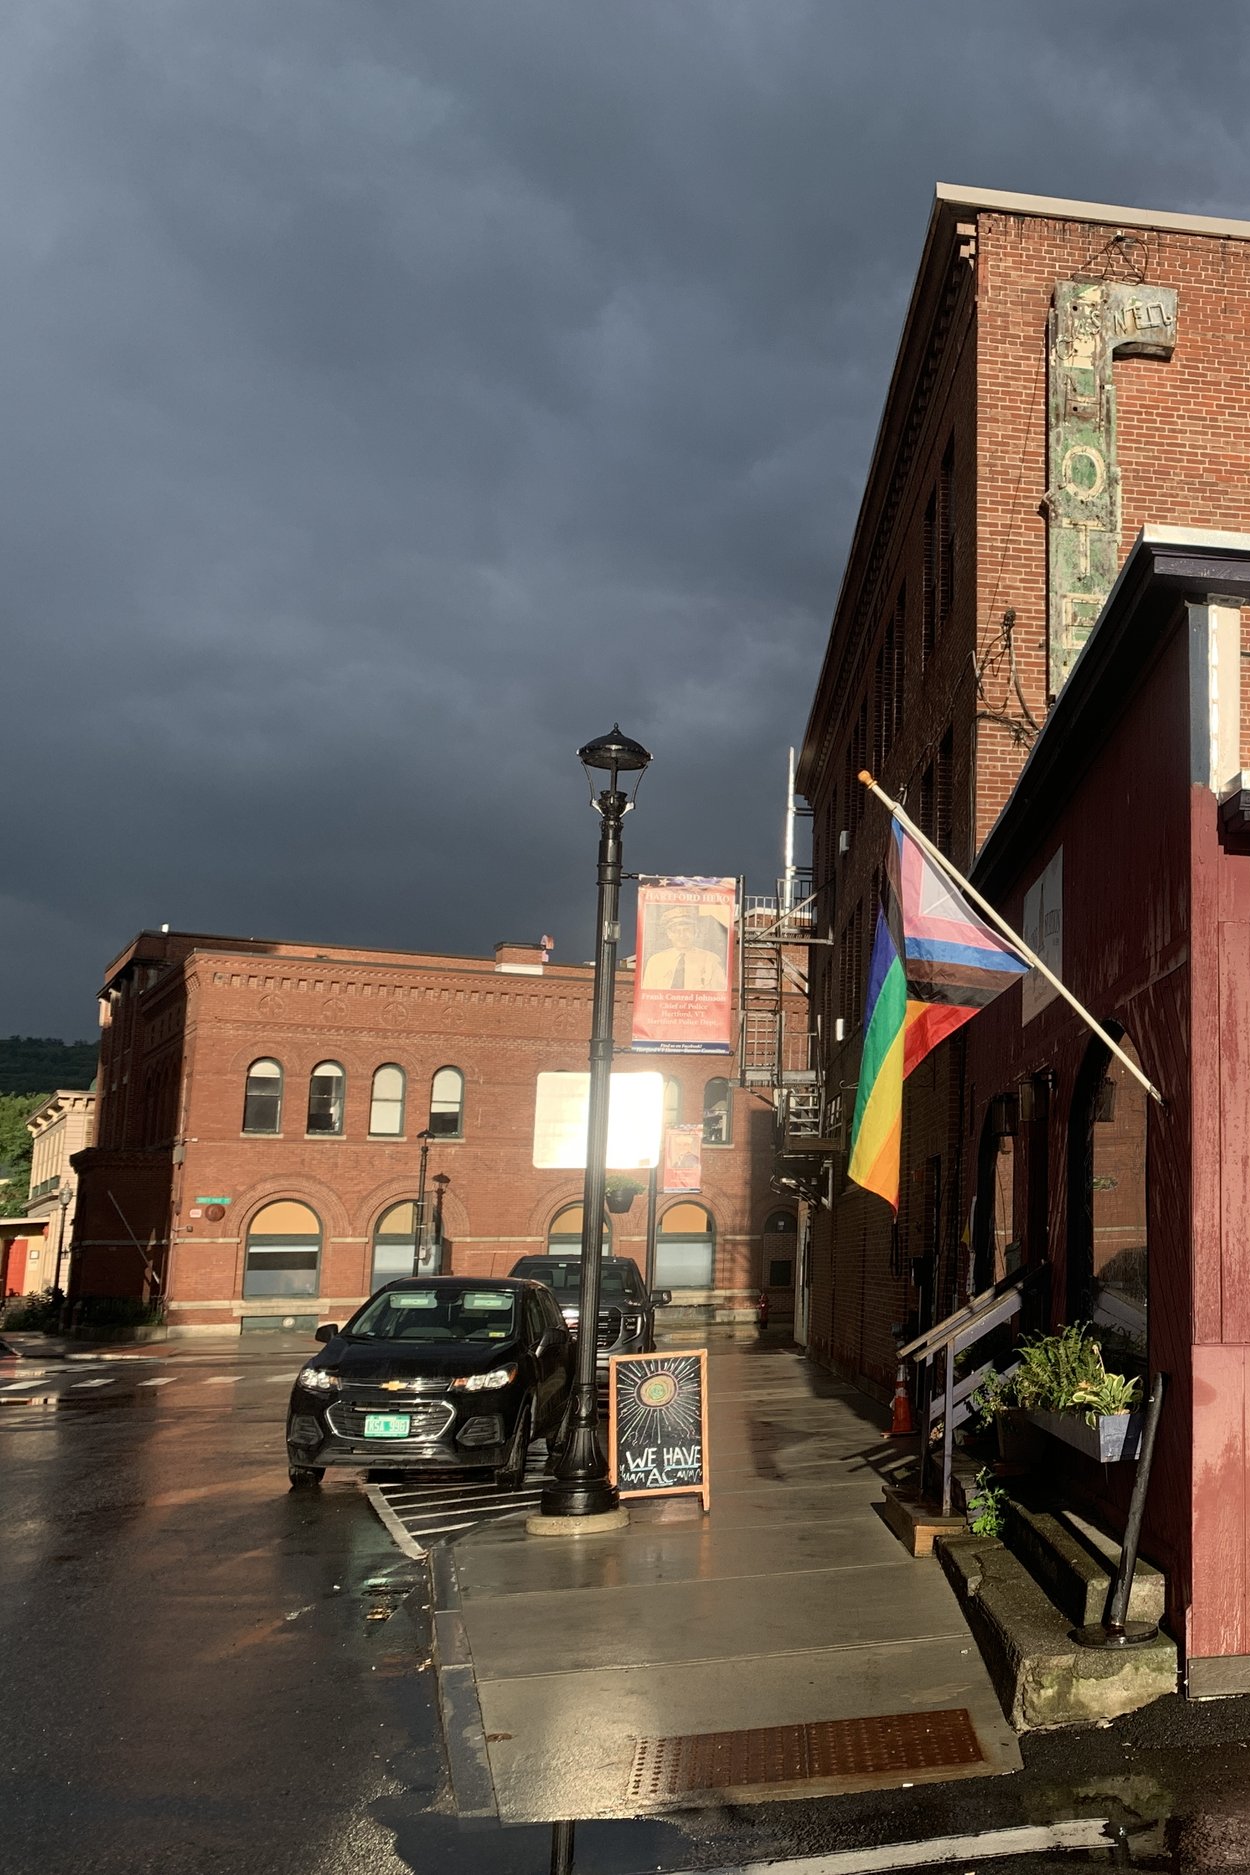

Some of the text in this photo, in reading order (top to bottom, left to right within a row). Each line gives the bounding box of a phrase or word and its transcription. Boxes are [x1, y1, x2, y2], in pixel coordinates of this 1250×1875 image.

[645, 890, 730, 905] HARTFORD HERO
[641, 992, 726, 1002] Frank Conrad Johnson
[660, 1002, 678, 1010] Chief
[687, 1003, 708, 1011] Police
[678, 1018, 698, 1026] Police
[625, 1445, 702, 1471] WE HAVE
